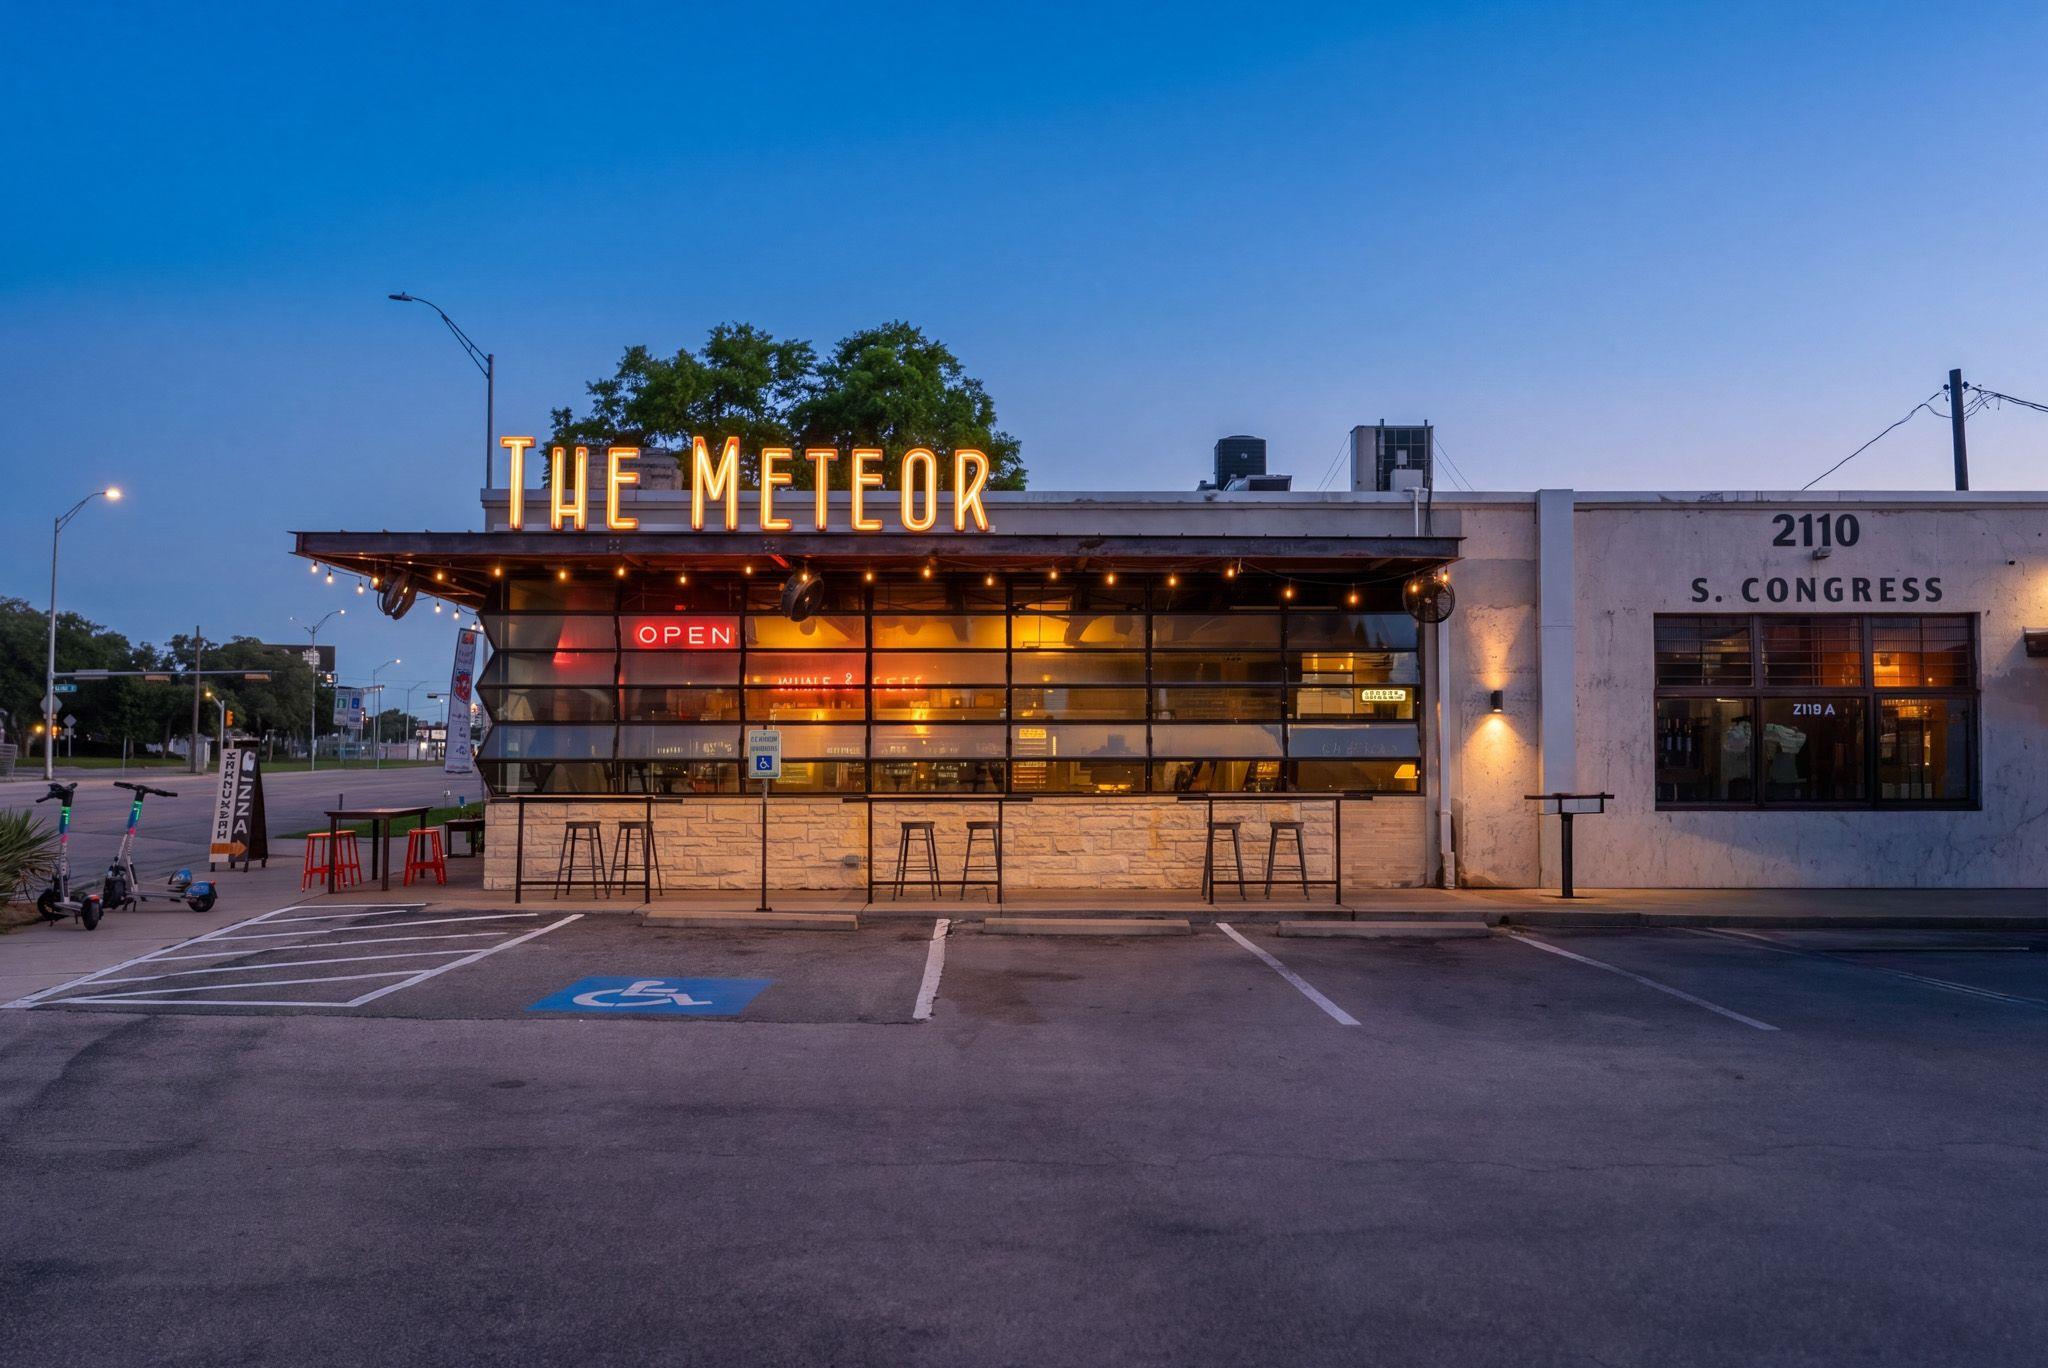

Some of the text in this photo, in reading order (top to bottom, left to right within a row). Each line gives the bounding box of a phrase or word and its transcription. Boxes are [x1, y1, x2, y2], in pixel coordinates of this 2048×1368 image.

[501, 436, 990, 532] THE METEOR
[1772, 513, 1860, 547] 2110
[1691, 577, 1943, 603] S. CONGRESS
[639, 625, 731, 645] OPEN
[1824, 703, 1836, 715] A
